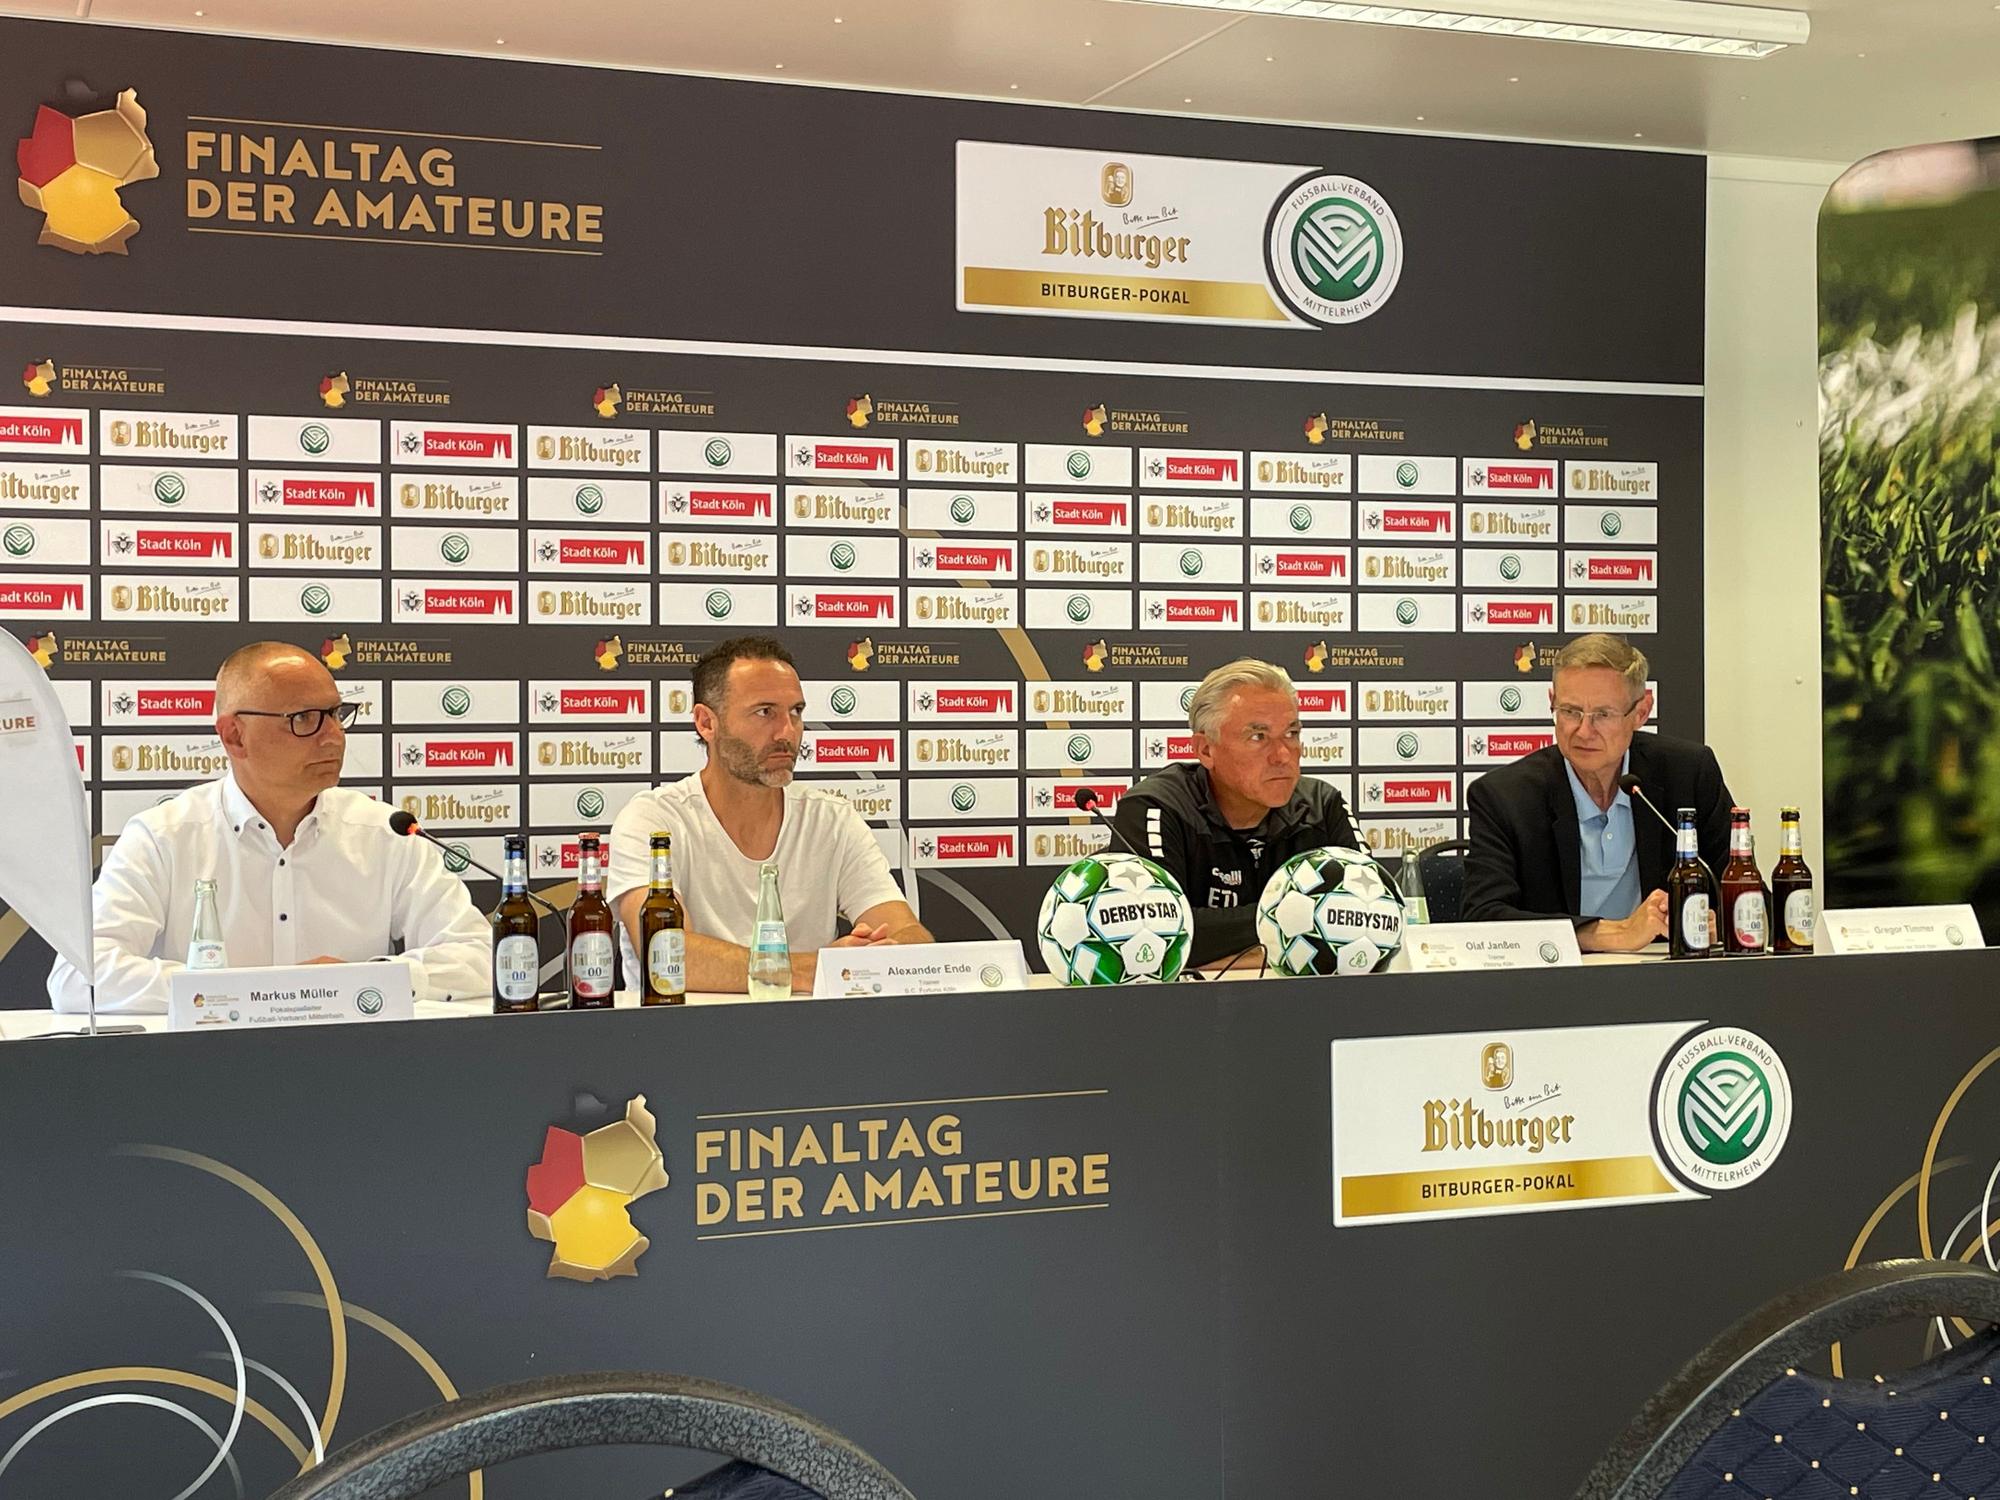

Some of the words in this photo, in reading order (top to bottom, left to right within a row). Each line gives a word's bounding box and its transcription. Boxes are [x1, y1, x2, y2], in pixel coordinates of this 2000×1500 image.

[187, 131, 455, 187] FINALTAG
[1291, 183, 1385, 216] FUSSBALL-VERBAND
[187, 179, 295, 224] DER
[313, 188, 603, 242] AMATEURE
[1041, 207, 1191, 268] Bitburger
[1041, 283, 1190, 304] BITBURGER-POKAL
[1303, 296, 1372, 317] MITTELRHEIN
[62, 368, 128, 380] FINALTAG
[62, 379, 90, 390] DER
[92, 380, 165, 393] AMATEURE
[355, 380, 417, 392] FINALTAG
[355, 391, 381, 402] DER
[383, 392, 452, 405] AMATEURE
[626, 391, 683, 403] FINALTAG
[626, 402, 650, 412] DER
[652, 403, 716, 415] AMATEURE
[877, 402, 931, 414] FINALTAG
[877, 412, 900, 421] DER
[901, 413, 961, 424] AMATEURE
[22, 424, 51, 437] Köln
[136, 421, 228, 453] Bitburger
[426, 438, 456, 450] Stadt
[458, 440, 484, 451] Köln
[559, 436, 641, 466] Bitburger
[817, 452, 844, 463] Stadt
[845, 453, 869, 464] Köln
[936, 450, 1009, 477] Bitburger
[1168, 464, 1193, 475] Stadt
[1194, 465, 1215, 475] Köln
[1276, 461, 1343, 488] Bitburger
[1489, 473, 1512, 483] Stadt
[1513, 473, 1533, 483] Köln
[1589, 470, 1650, 494] Bitburger
[0, 473, 80, 504] itburger
[285, 487, 317, 499] Stadt
[319, 488, 345, 500] Köln
[424, 484, 508, 514] Bitburger
[692, 498, 720, 510] Stadt
[721, 499, 745, 510] Köln
[815, 495, 891, 523] Bitburger
[1055, 508, 1080, 519] Stadt
[1081, 509, 1103, 520] Köln
[1167, 505, 1235, 532] Bitburger
[1385, 516, 1408, 526] Stadt
[1409, 516, 1430, 527] Köln
[1487, 513, 1550, 537] Bitburger
[139, 538, 172, 550] Stadt
[174, 538, 202, 550] Köln
[282, 534, 371, 564] Bitburger
[562, 546, 592, 558] Stadt
[593, 547, 618, 558] Köln
[689, 542, 768, 570] Bitburger
[938, 554, 964, 565] Stadt
[966, 554, 988, 565] Köln
[1053, 550, 1124, 577] Bitburger
[1278, 560, 1302, 571] Stadt
[1303, 560, 1324, 571] Köln
[1383, 556, 1449, 581] Bitburger
[1590, 565, 1612, 575] Stadt
[1613, 565, 1632, 575] Köln
[22, 591, 52, 603] Köln
[136, 585, 228, 615] Bitburger
[427, 596, 457, 608] Stadt
[459, 596, 485, 608] Köln
[559, 591, 641, 619] Bitburger
[817, 601, 845, 612] Stadt
[846, 601, 869, 612] Köln
[936, 596, 1009, 623] Bitburger
[1168, 605, 1193, 616] Stadt
[1194, 606, 1215, 616] Köln
[1276, 601, 1343, 626] Bitburger
[1489, 609, 1512, 619] Stadt
[1513, 609, 1532, 619] Köln
[1589, 604, 1650, 628] Bitburger
[63, 640, 129, 651] FINALTAG
[356, 641, 418, 652] FINALTAG
[627, 643, 684, 653] FINALTAG
[877, 645, 931, 654] FINALTAG
[63, 651, 91, 662] DER
[93, 651, 166, 663] AMATEURE
[356, 652, 382, 663] DER
[384, 652, 453, 663] AMATEURE
[627, 653, 651, 663] DER
[877, 654, 900, 664] DER
[901, 654, 961, 664] AMATEURE
[140, 697, 172, 709] Stadt
[175, 697, 203, 709] Köln
[563, 696, 592, 708] Stadt
[594, 696, 619, 707] Köln
[938, 696, 964, 707] Stadt
[966, 696, 988, 707] Köln
[1053, 691, 1124, 716] Bitburger
[1383, 691, 1449, 715] Bitburger
[818, 746, 845, 757] Stadt
[846, 745, 870, 757] Köln
[936, 739, 1009, 765] Bitburger
[1168, 743, 1194, 754] Stadt
[1489, 741, 1512, 751] Stadt
[1513, 740, 1533, 750] Köln
[136, 745, 228, 774] Bitburger
[428, 749, 458, 761] Stadt
[460, 749, 486, 760] Köln
[559, 742, 641, 769] Bitburger
[1386, 788, 1409, 798] Stadt
[1410, 787, 1430, 797] Köln
[424, 794, 508, 822] Bitburger
[939, 842, 965, 853] Stadt
[967, 842, 989, 852] Köln
[1099, 902, 1178, 925] DERBYSTAR
[1326, 908, 1399, 933] DERBYSTAR
[1465, 941, 1485, 951] Olaf
[888, 965, 941, 976] Alexander
[944, 963, 972, 974] Ende
[250, 990, 296, 1002] Markus
[300, 988, 339, 1000] Müller
[1677, 1035, 1772, 1070] FUSSBALL-VERBAND
[1421, 1097, 1575, 1153] Bitburger
[696, 1114, 961, 1174] FINALTAG
[1691, 1158, 1761, 1182] MITTELRHEIN
[696, 1178, 804, 1227] DER
[821, 1154, 1109, 1216] AMATEURE
[1422, 1174, 1575, 1199] BITBURGER-POKAL
